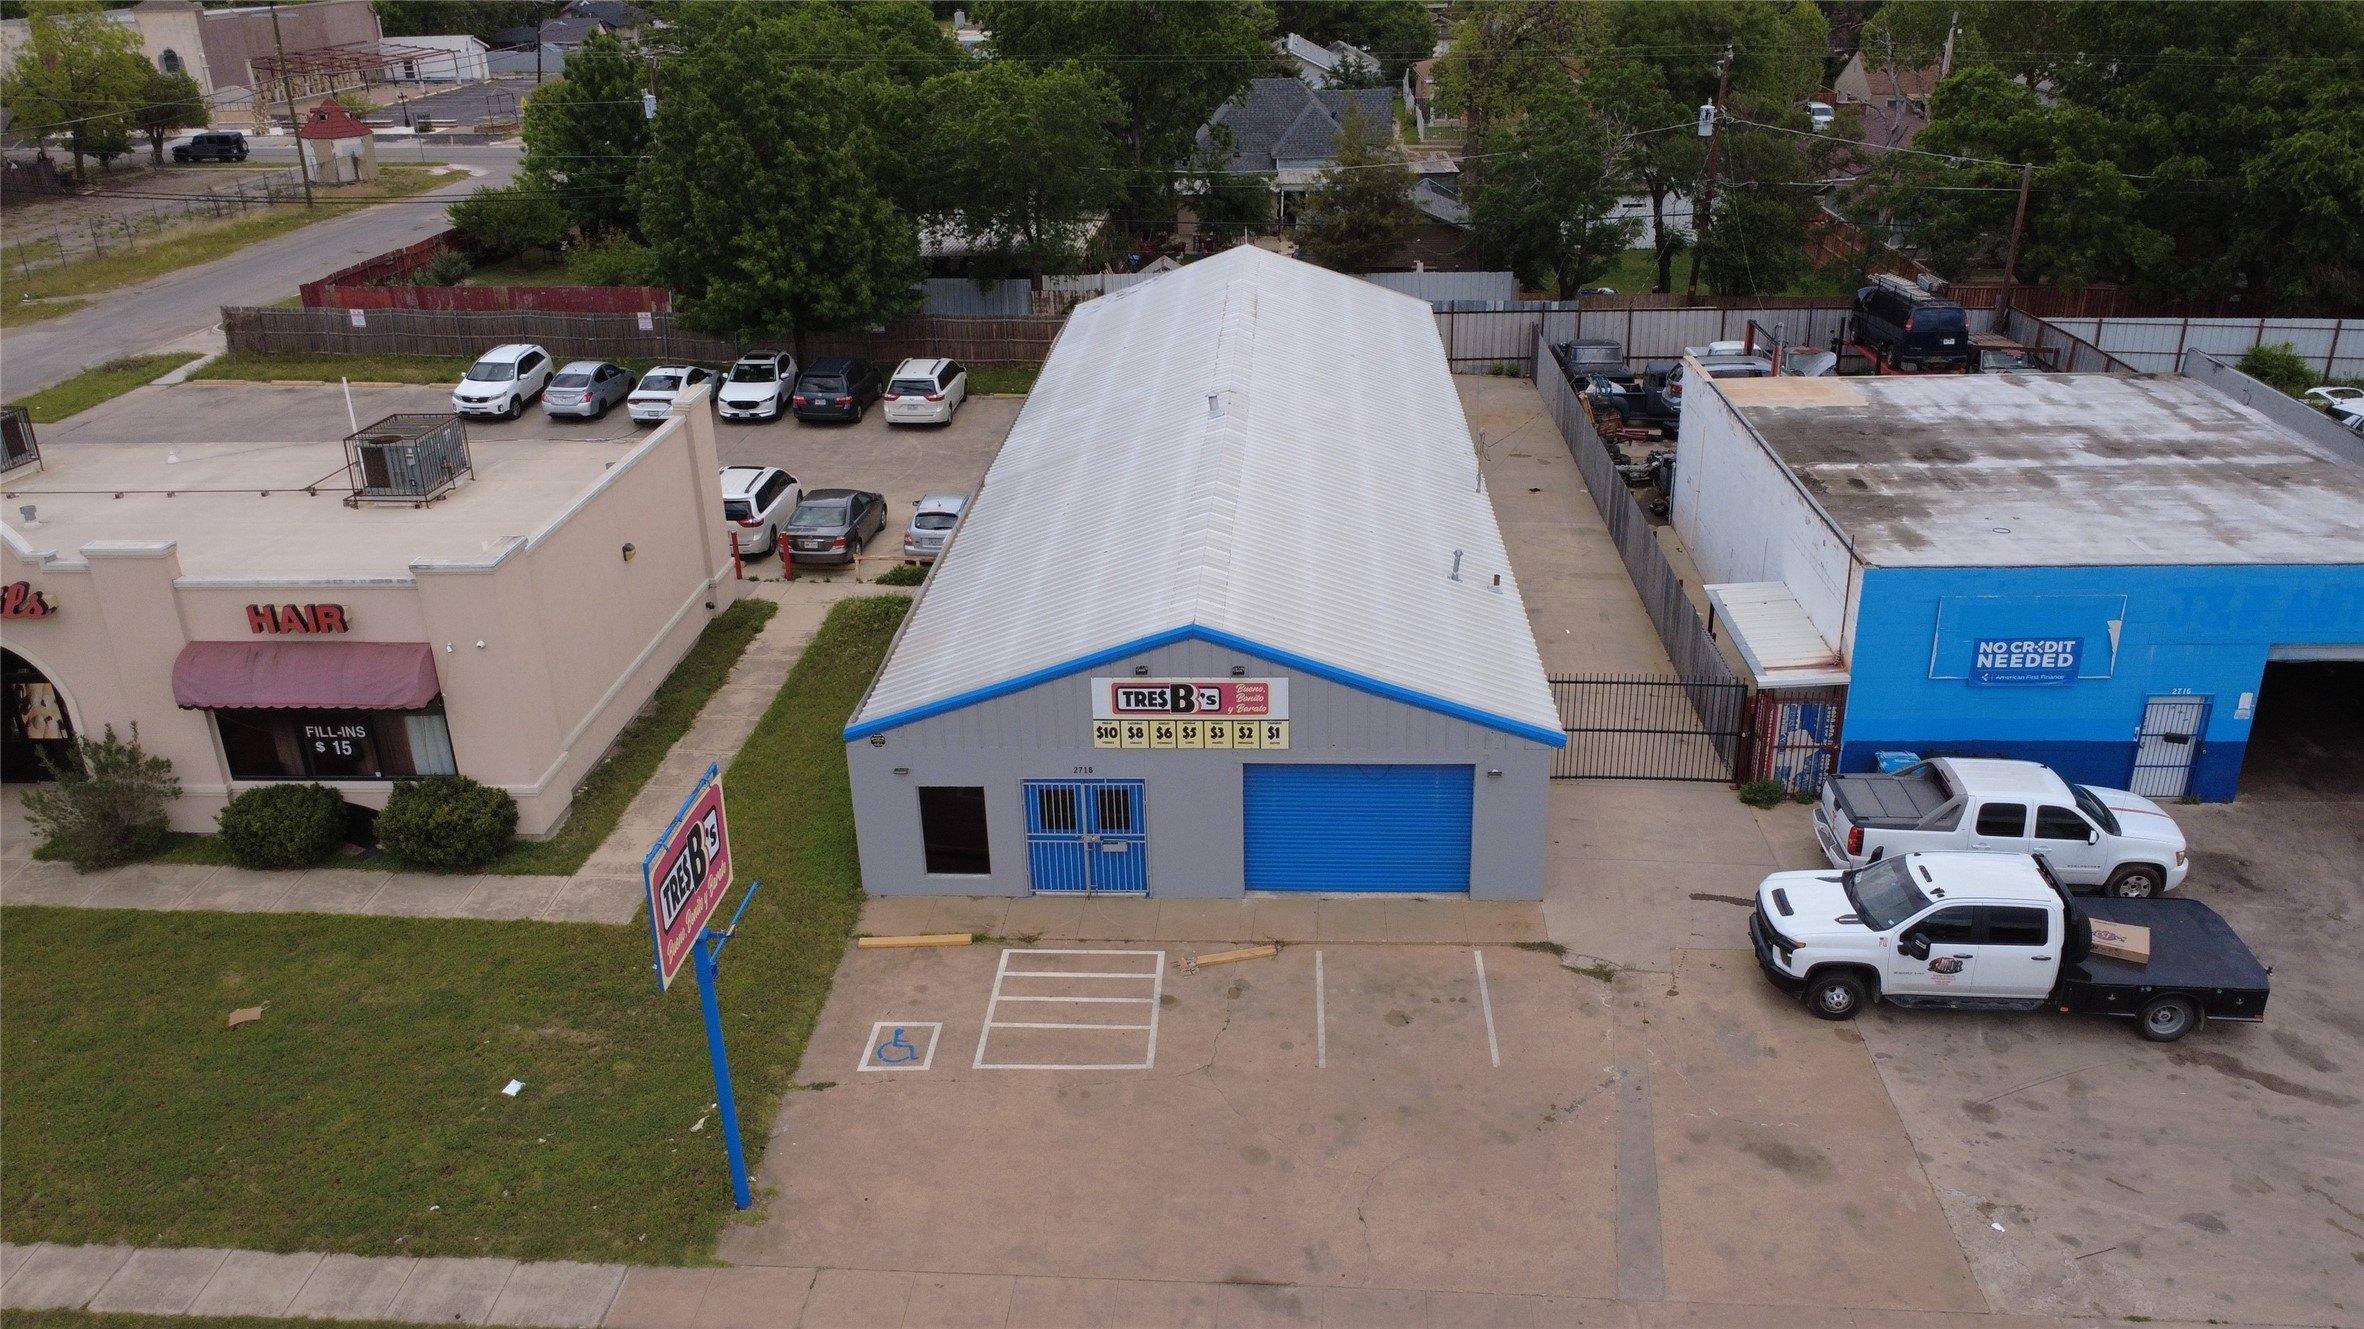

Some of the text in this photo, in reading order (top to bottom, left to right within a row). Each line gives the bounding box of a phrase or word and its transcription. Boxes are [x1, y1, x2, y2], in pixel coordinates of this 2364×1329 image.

[246, 604, 349, 634] HAIR
[1979, 641, 2007, 653] NO
[1976, 653, 2074, 668] NEEDED
[1235, 692, 1264, 703] Bonito
[2171, 687, 2191, 695] 2716
[1227, 703, 1267, 715] y Barato
[305, 726, 366, 738] FILL-INS
[1096, 726, 1118, 739] $10
[1128, 726, 1144, 739] $8
[1156, 726, 1173, 740] $6
[1182, 726, 1197, 739] $5
[1211, 726, 1225, 739] $3
[1239, 726, 1254, 739] $2
[1267, 726, 1280, 740] $1
[315, 740, 352, 755] $ 15
[1073, 766, 1093, 774] 2718
